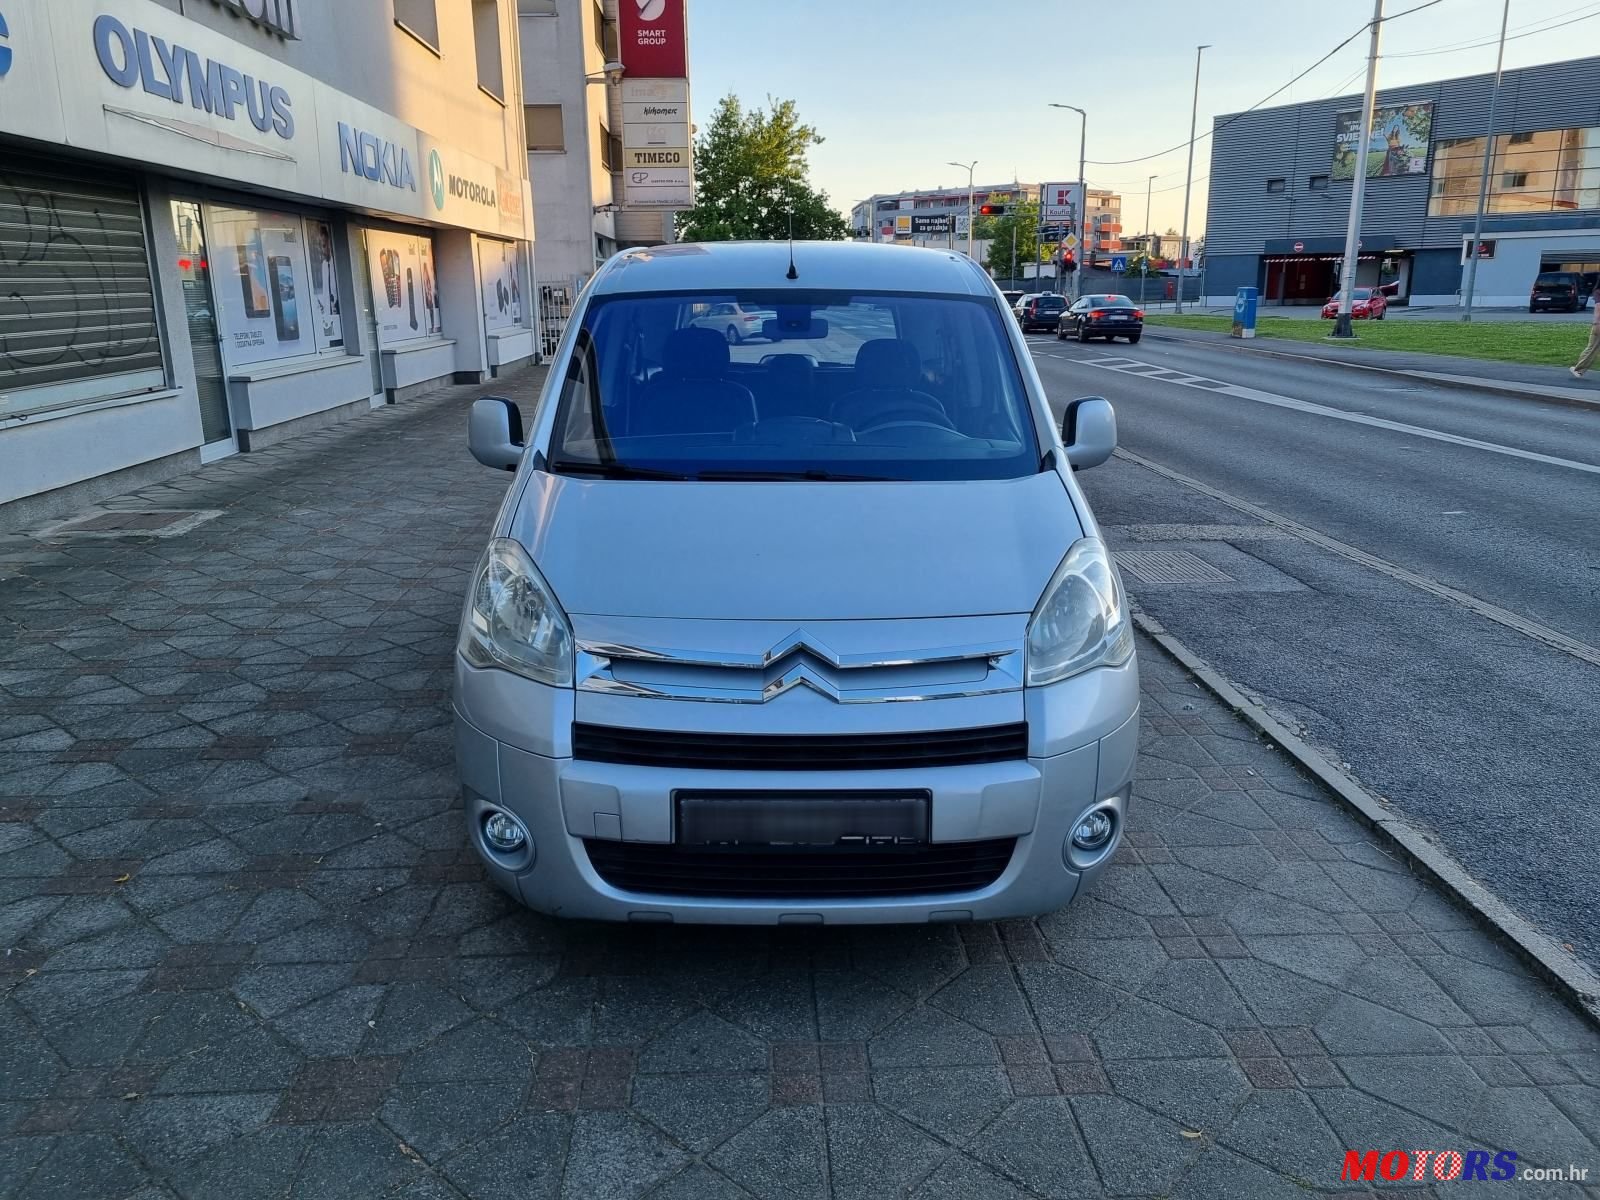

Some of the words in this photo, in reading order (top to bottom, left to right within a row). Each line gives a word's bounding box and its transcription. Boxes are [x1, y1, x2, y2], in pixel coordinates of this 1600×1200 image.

[637, 29, 666, 37] SMART
[93, 14, 295, 140] OLYMPUS
[337, 121, 417, 192] NOKIA
[634, 151, 680, 164] TIMECO
[449, 174, 496, 208] MOTOROLA
